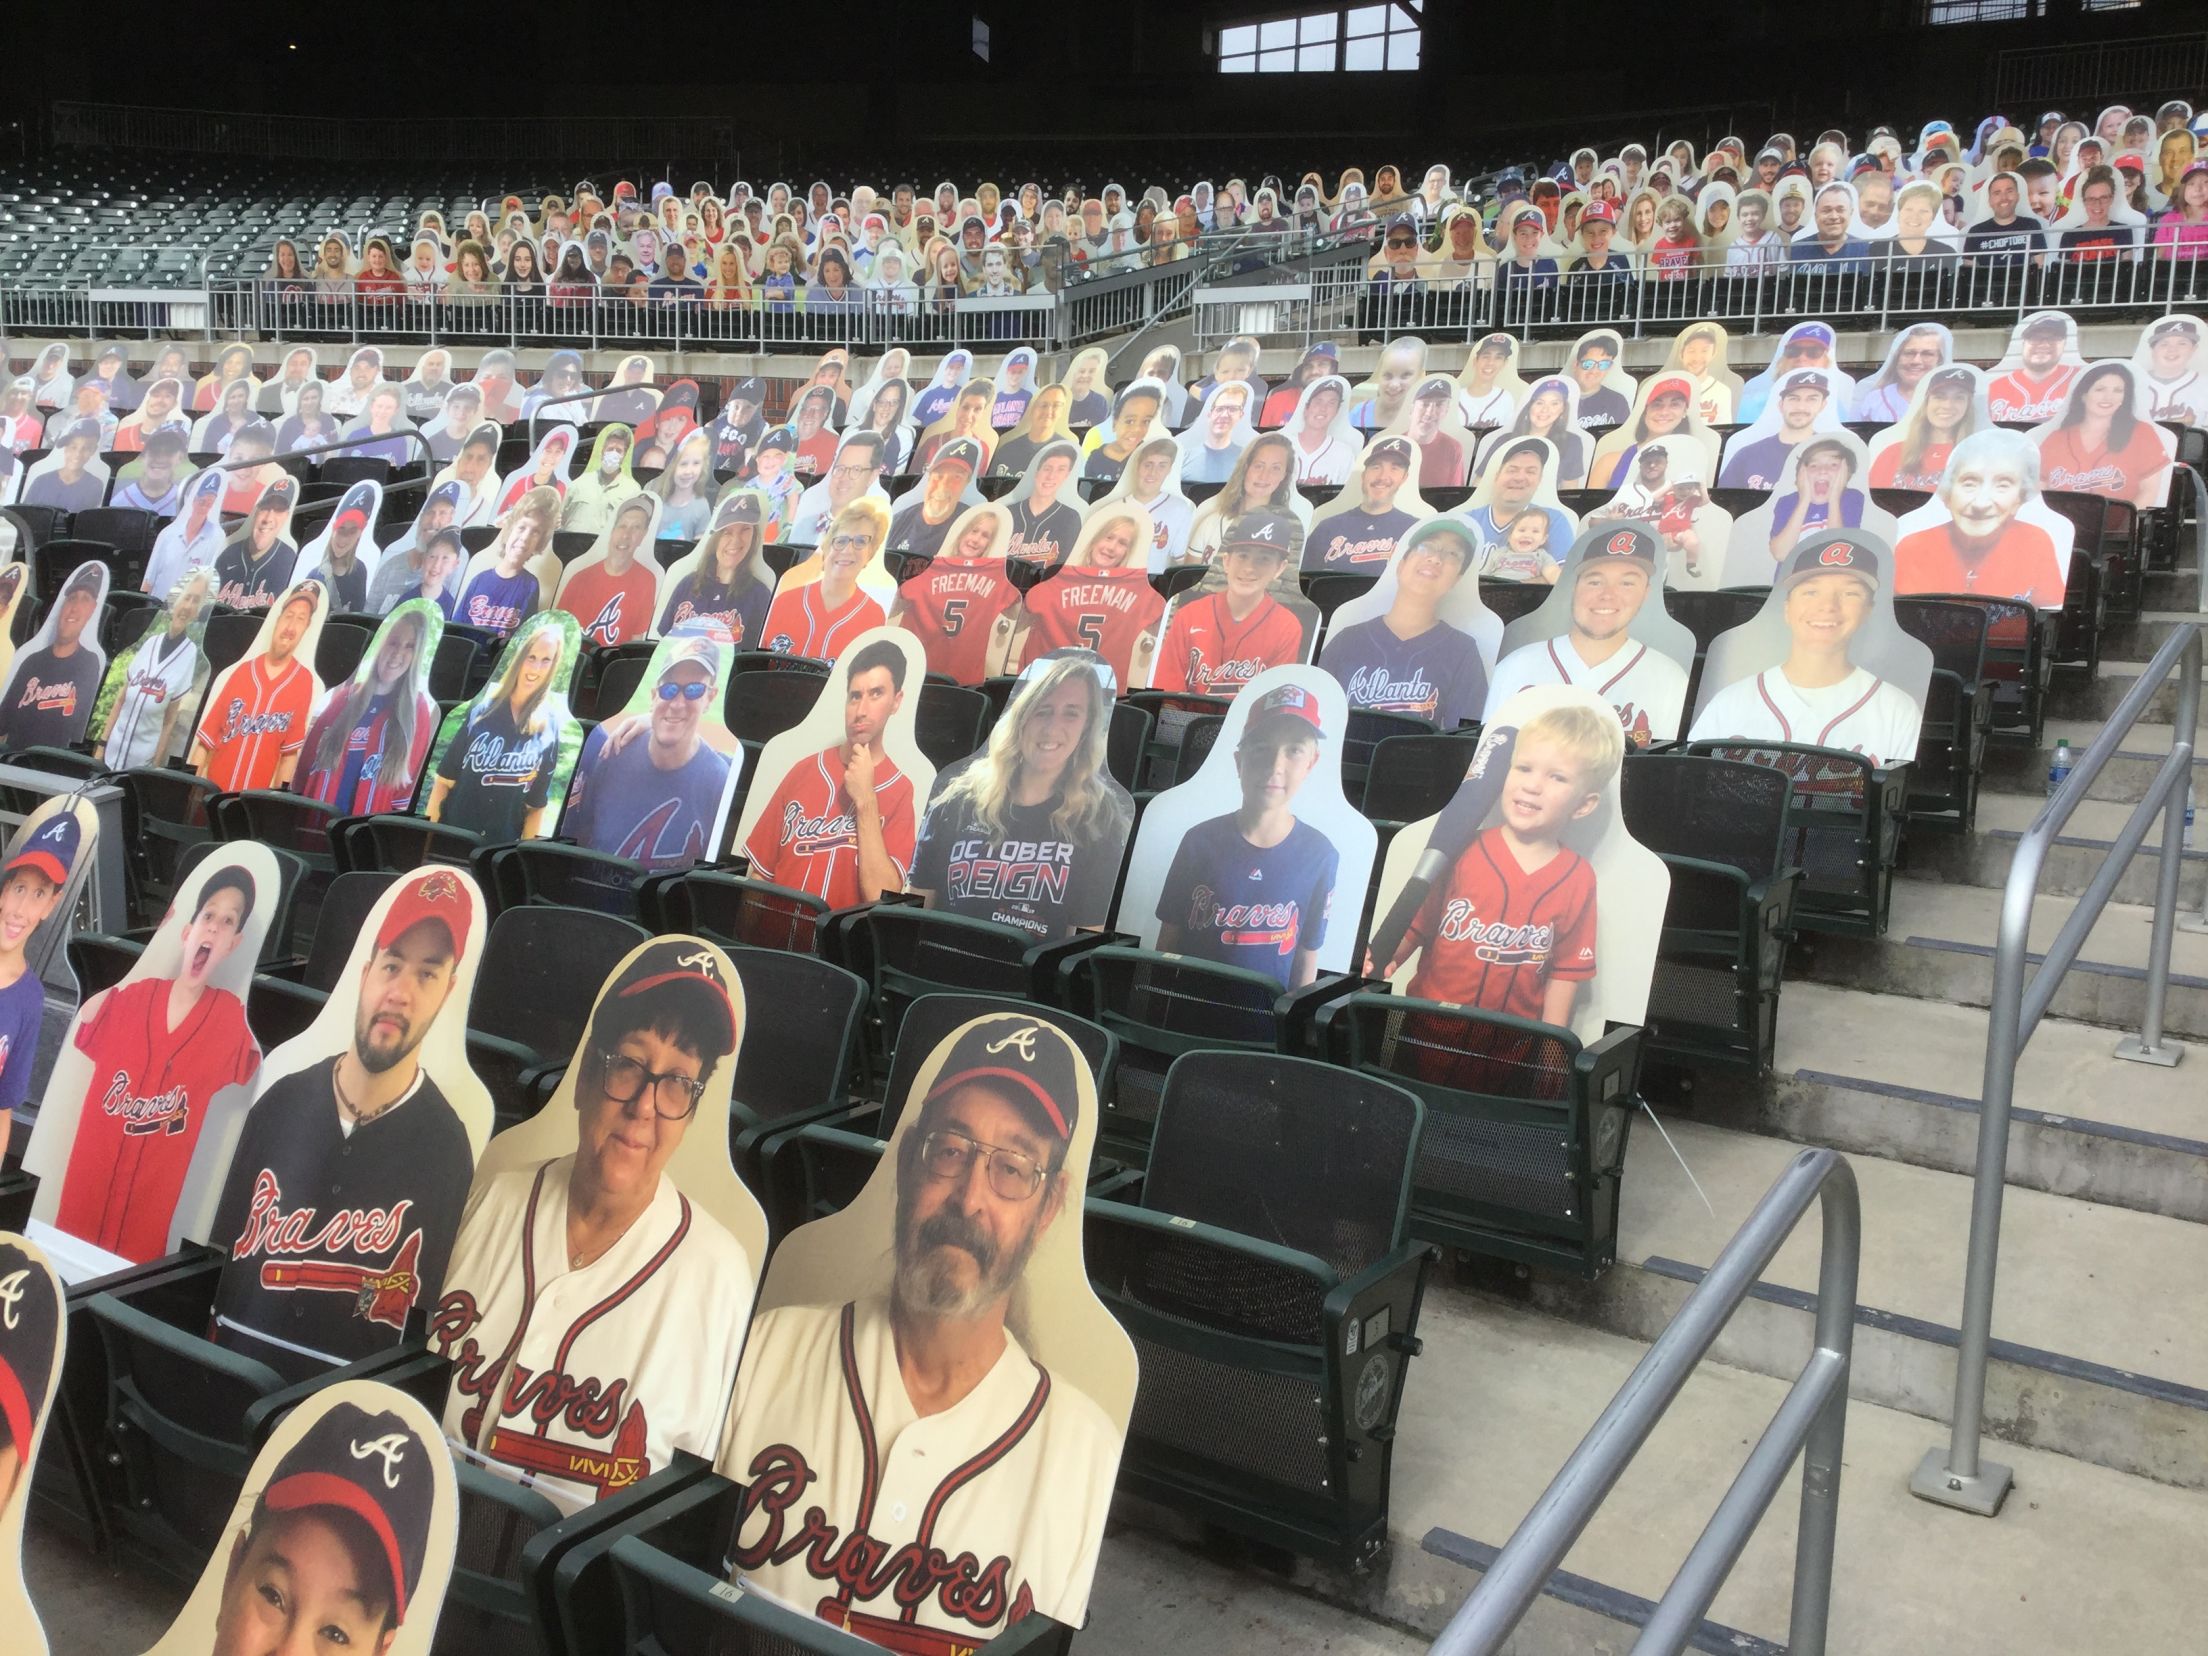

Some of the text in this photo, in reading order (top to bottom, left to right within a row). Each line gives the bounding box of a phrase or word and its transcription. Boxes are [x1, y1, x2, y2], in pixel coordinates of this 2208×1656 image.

[931, 572, 997, 596] FREEMAN
[1061, 584, 1138, 613] FREEMAN
[942, 600, 968, 637] 5
[1077, 614, 1105, 649] 5
[1347, 666, 1431, 701] Atlanta
[948, 860, 1071, 904] REIGN
[992, 911, 1048, 934] CHAMPIONS
[1188, 885, 1297, 930] Braves
[986, 1026, 1039, 1062] A
[232, 1168, 413, 1261] Braves
[350, 1434, 409, 1488] A
[735, 1443, 1011, 1628] Braves
